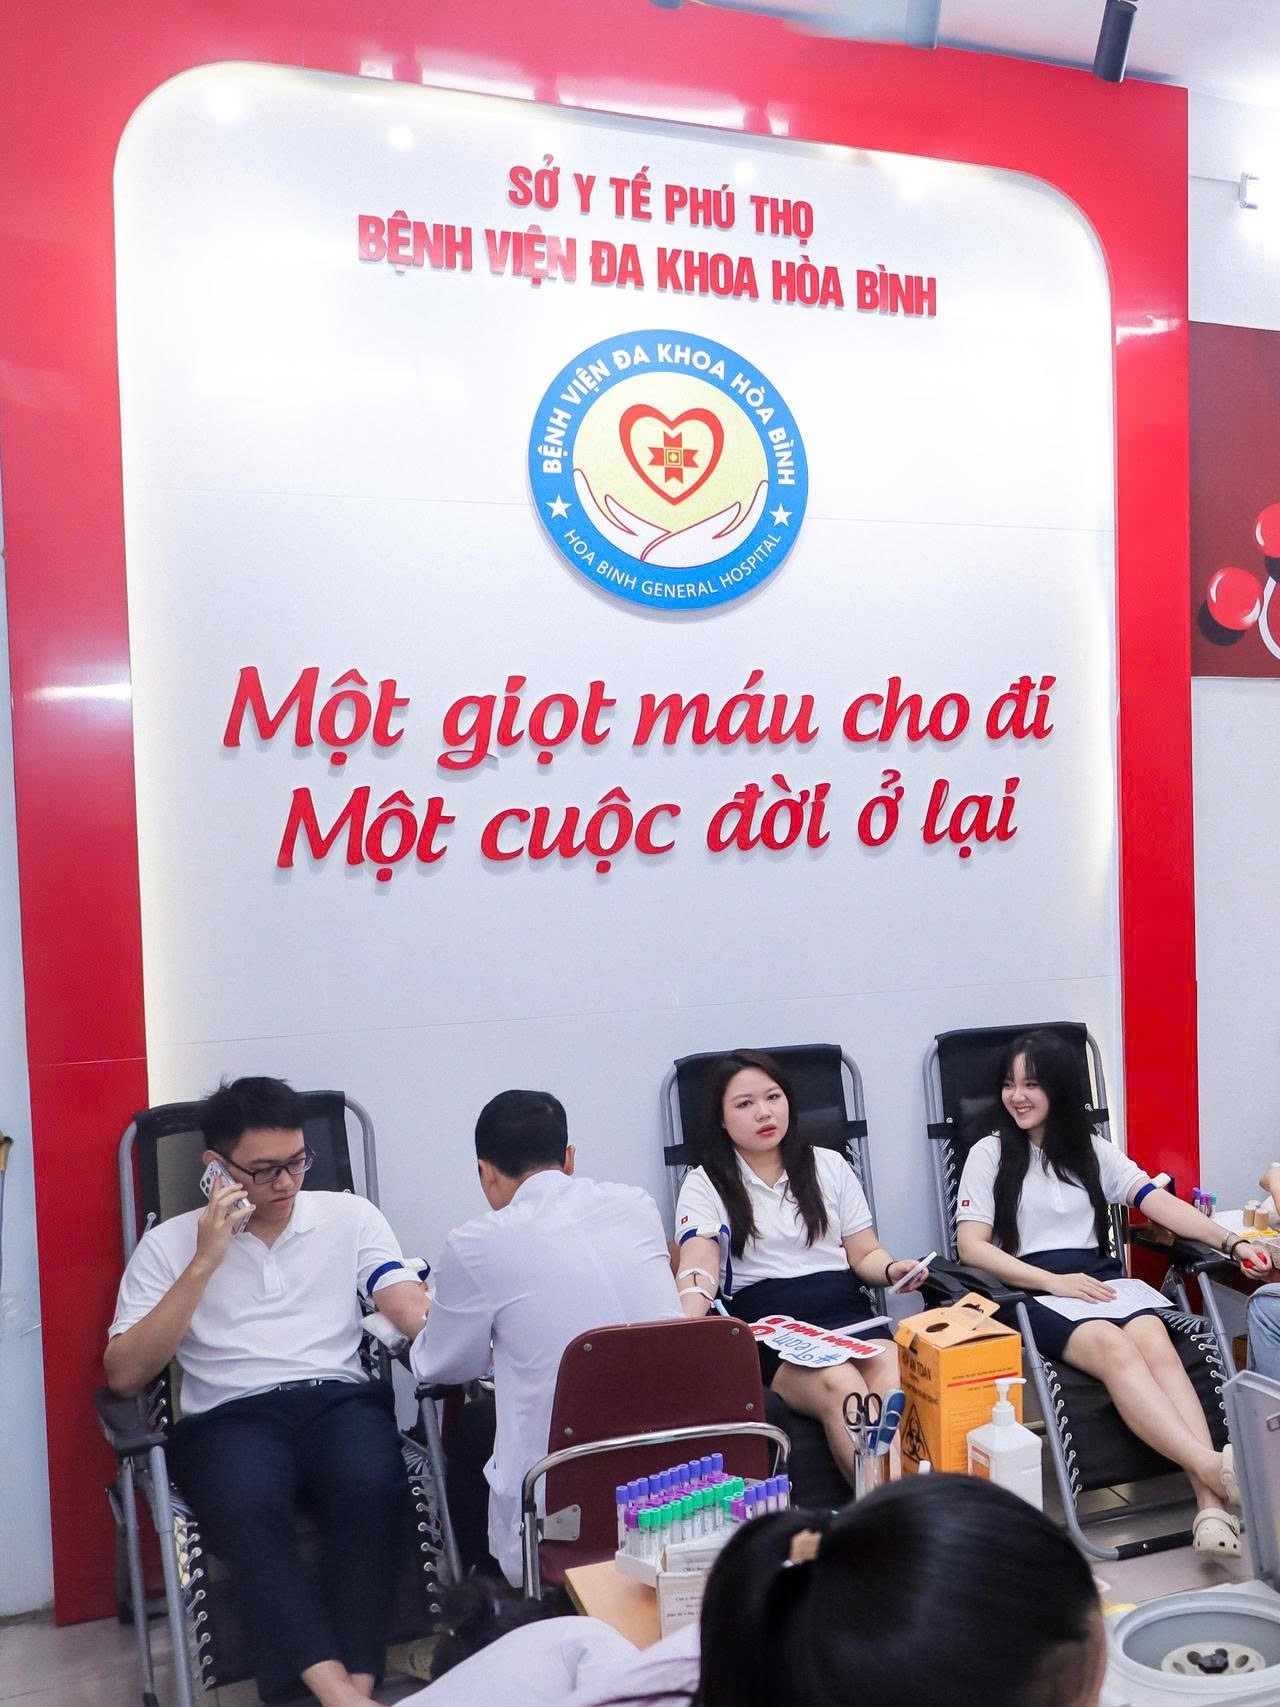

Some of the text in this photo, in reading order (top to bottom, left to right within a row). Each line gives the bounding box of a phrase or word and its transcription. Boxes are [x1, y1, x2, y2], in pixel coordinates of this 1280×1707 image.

[508, 155, 814, 246] SỞ Y TẾ PHÚ THỌ
[358, 210, 937, 317] BỆNH VIỆN ĐA KHOA HÒA BÌNH
[537, 343, 796, 486] BỆNH VIỆN ĐA KHOA HÒA BÌNH
[563, 528, 782, 599] HOA BINH GENERAL HOSPITAL
[223, 666, 1056, 771] Một giọt máu cho đi
[276, 769, 1020, 882] Một cuộc đời ở lại
